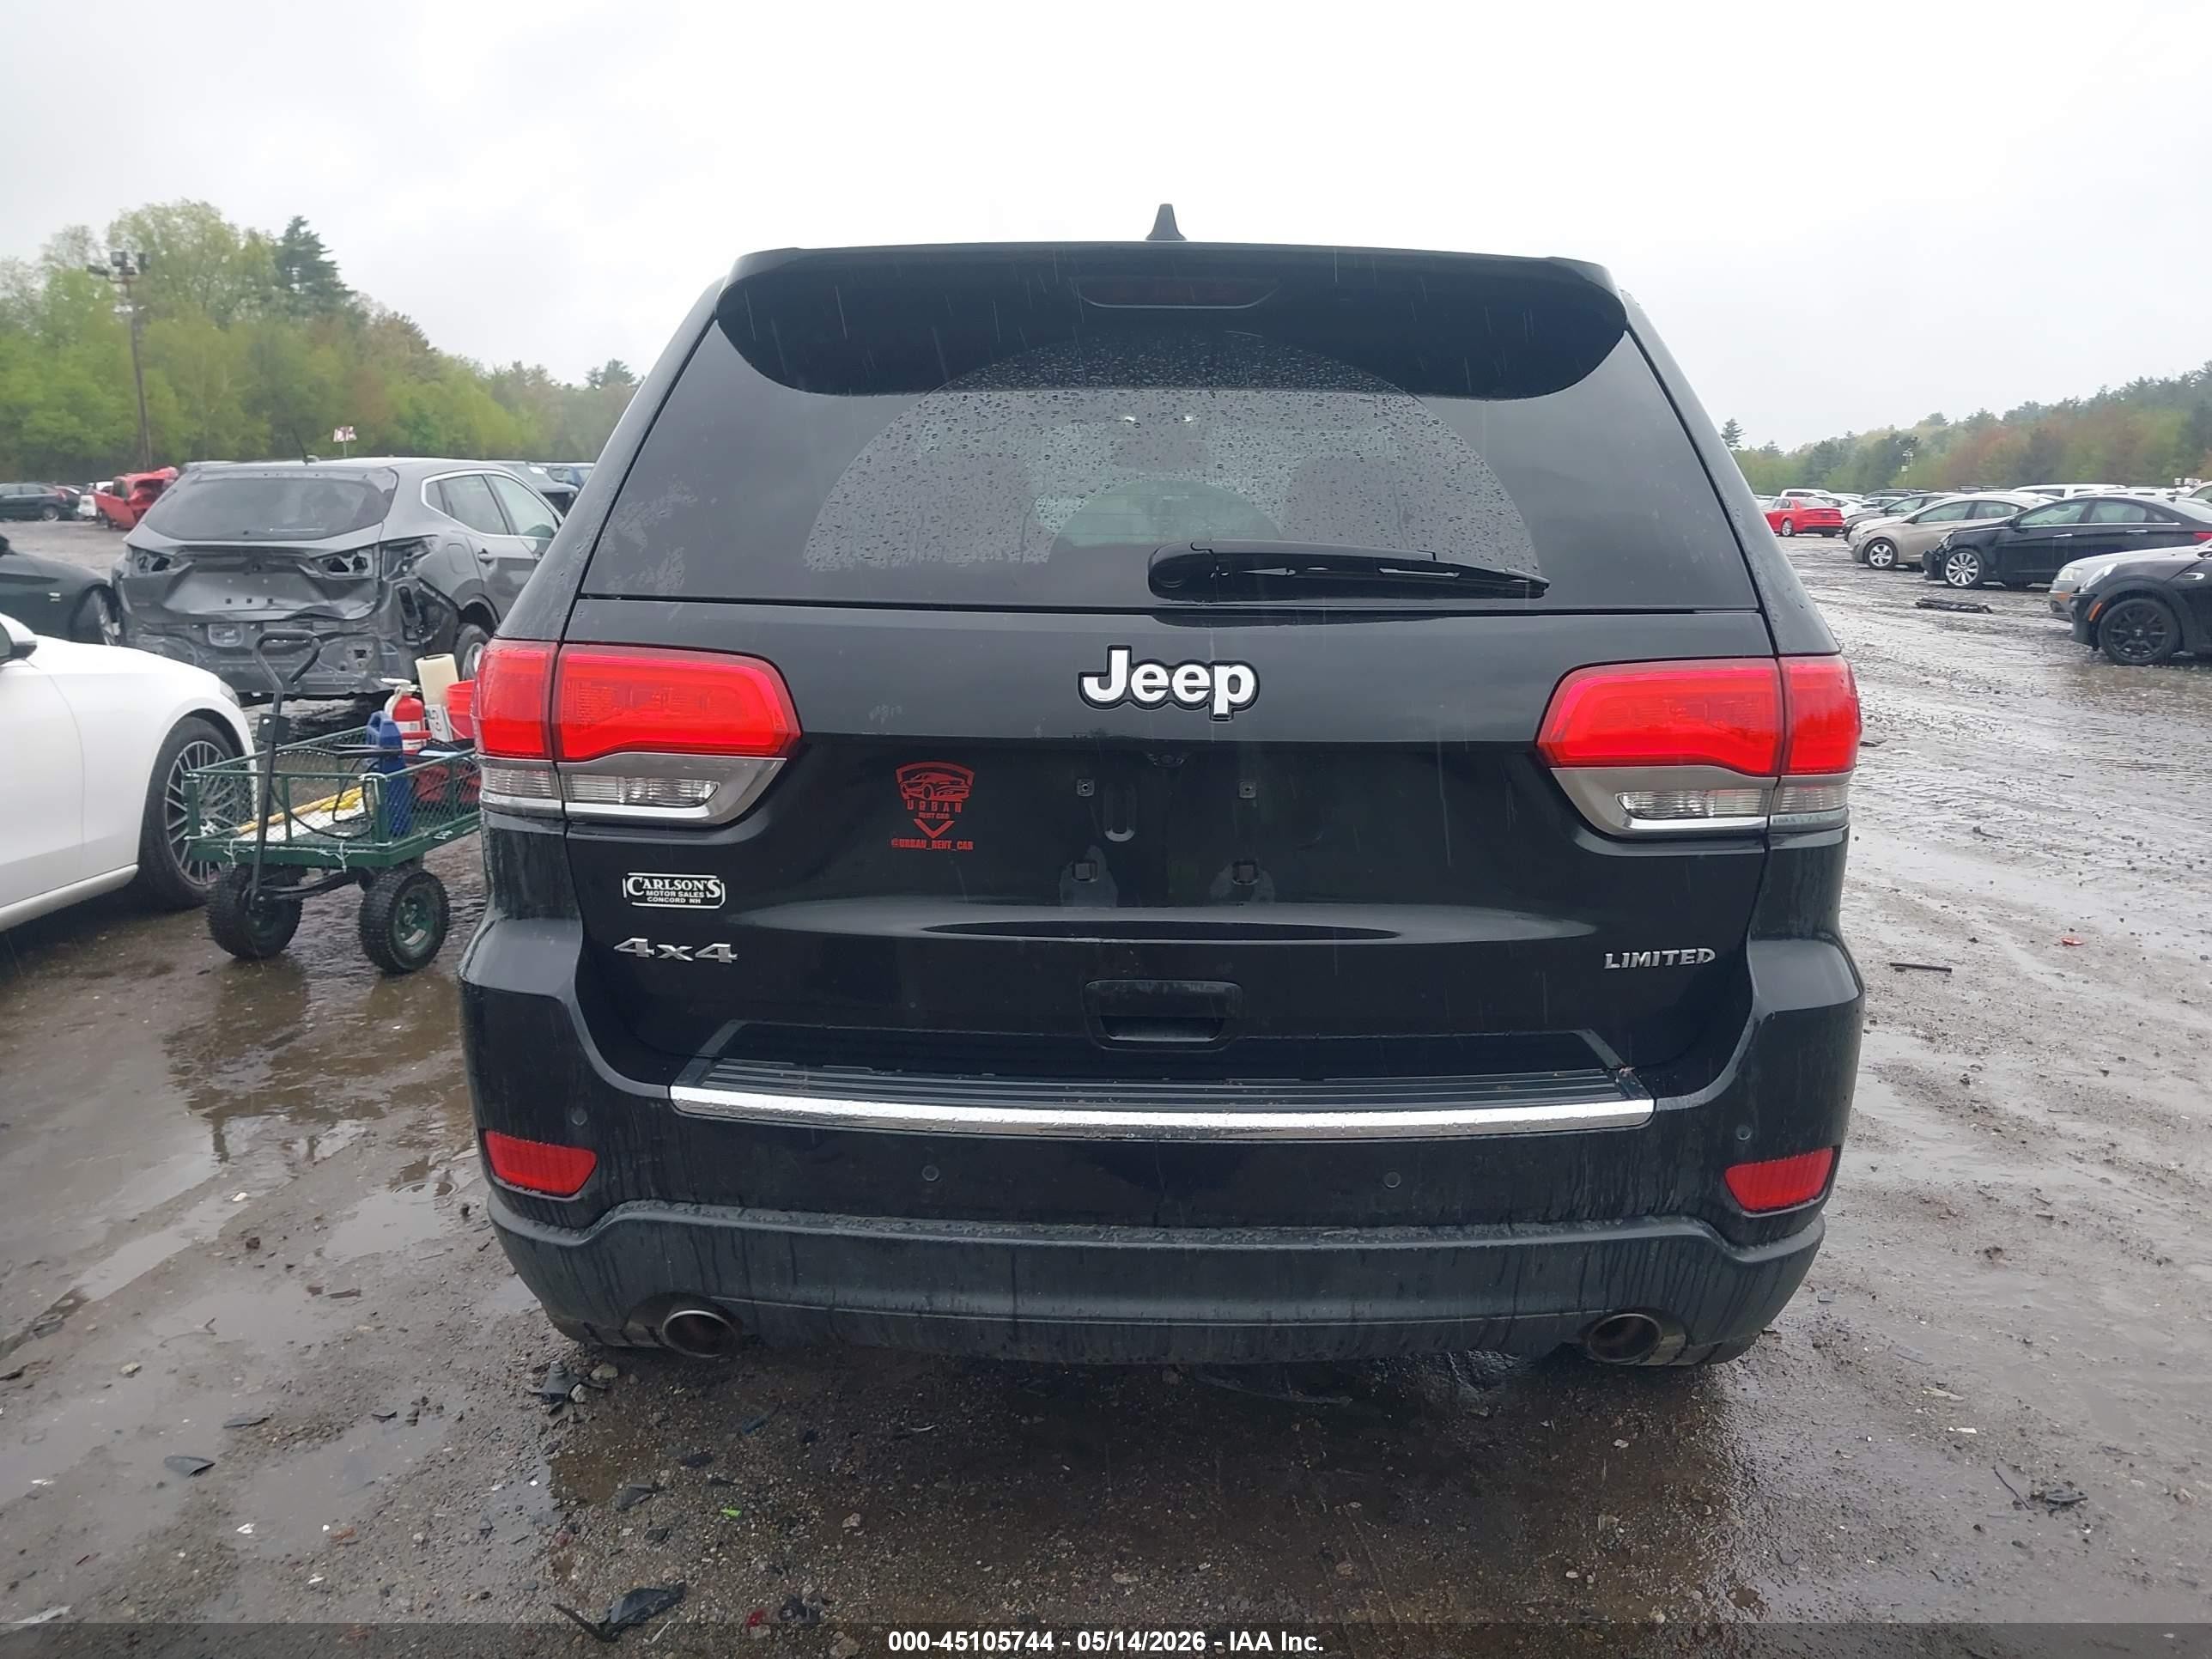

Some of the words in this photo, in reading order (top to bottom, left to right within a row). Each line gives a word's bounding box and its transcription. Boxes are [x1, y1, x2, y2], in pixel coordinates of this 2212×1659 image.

[1081, 647, 1257, 717] Jeep
[907, 799, 962, 812] URBAN
[1604, 948, 1716, 969] LIMITED
